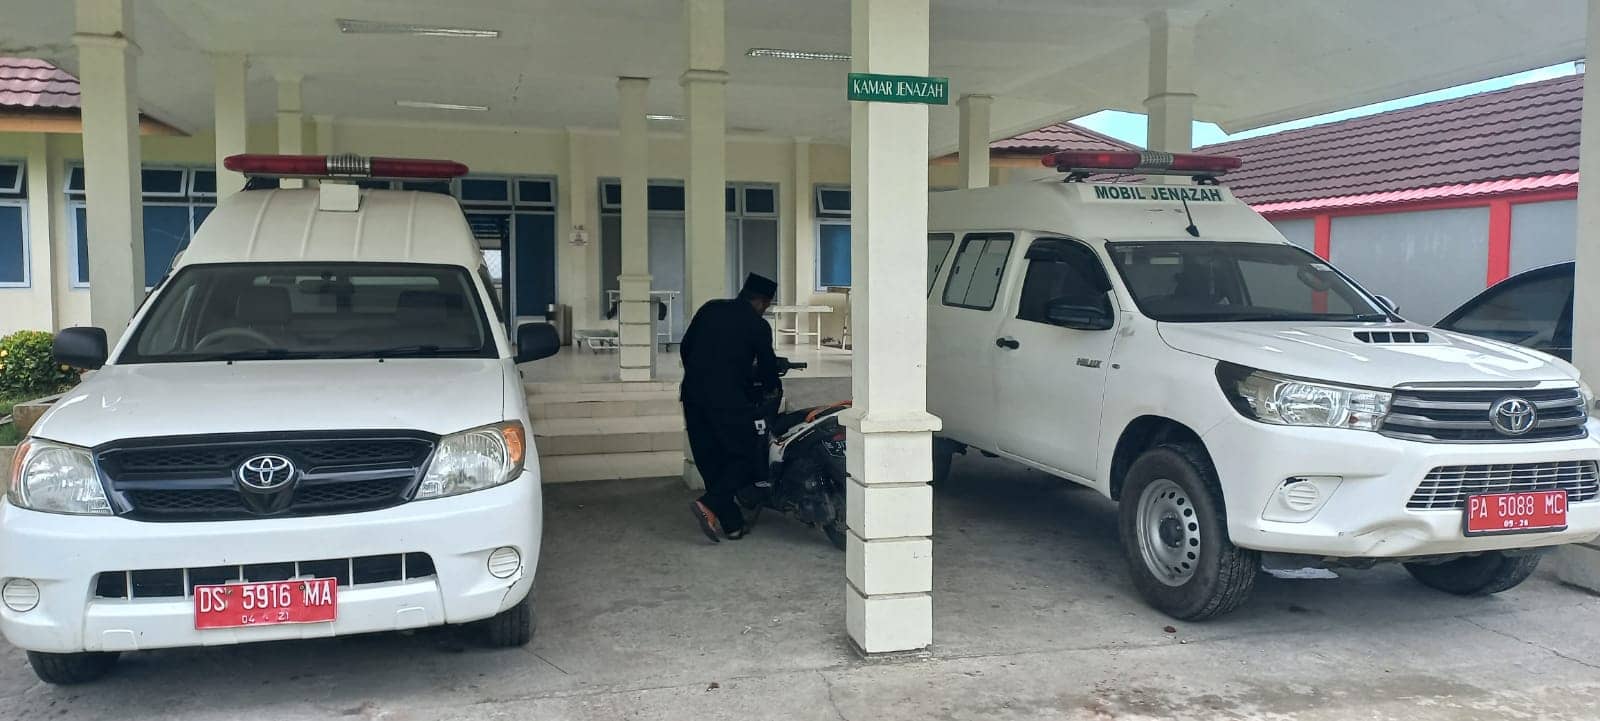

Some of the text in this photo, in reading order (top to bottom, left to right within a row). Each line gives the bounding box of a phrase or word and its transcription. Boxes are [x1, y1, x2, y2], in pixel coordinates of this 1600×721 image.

[853, 79, 943, 98] KAMAR JENAZAH
[1094, 185, 1222, 202] MOBIL JENAZAH
[1470, 494, 1564, 519] PA 5088 MC
[199, 580, 332, 613] DS 5916 MA
